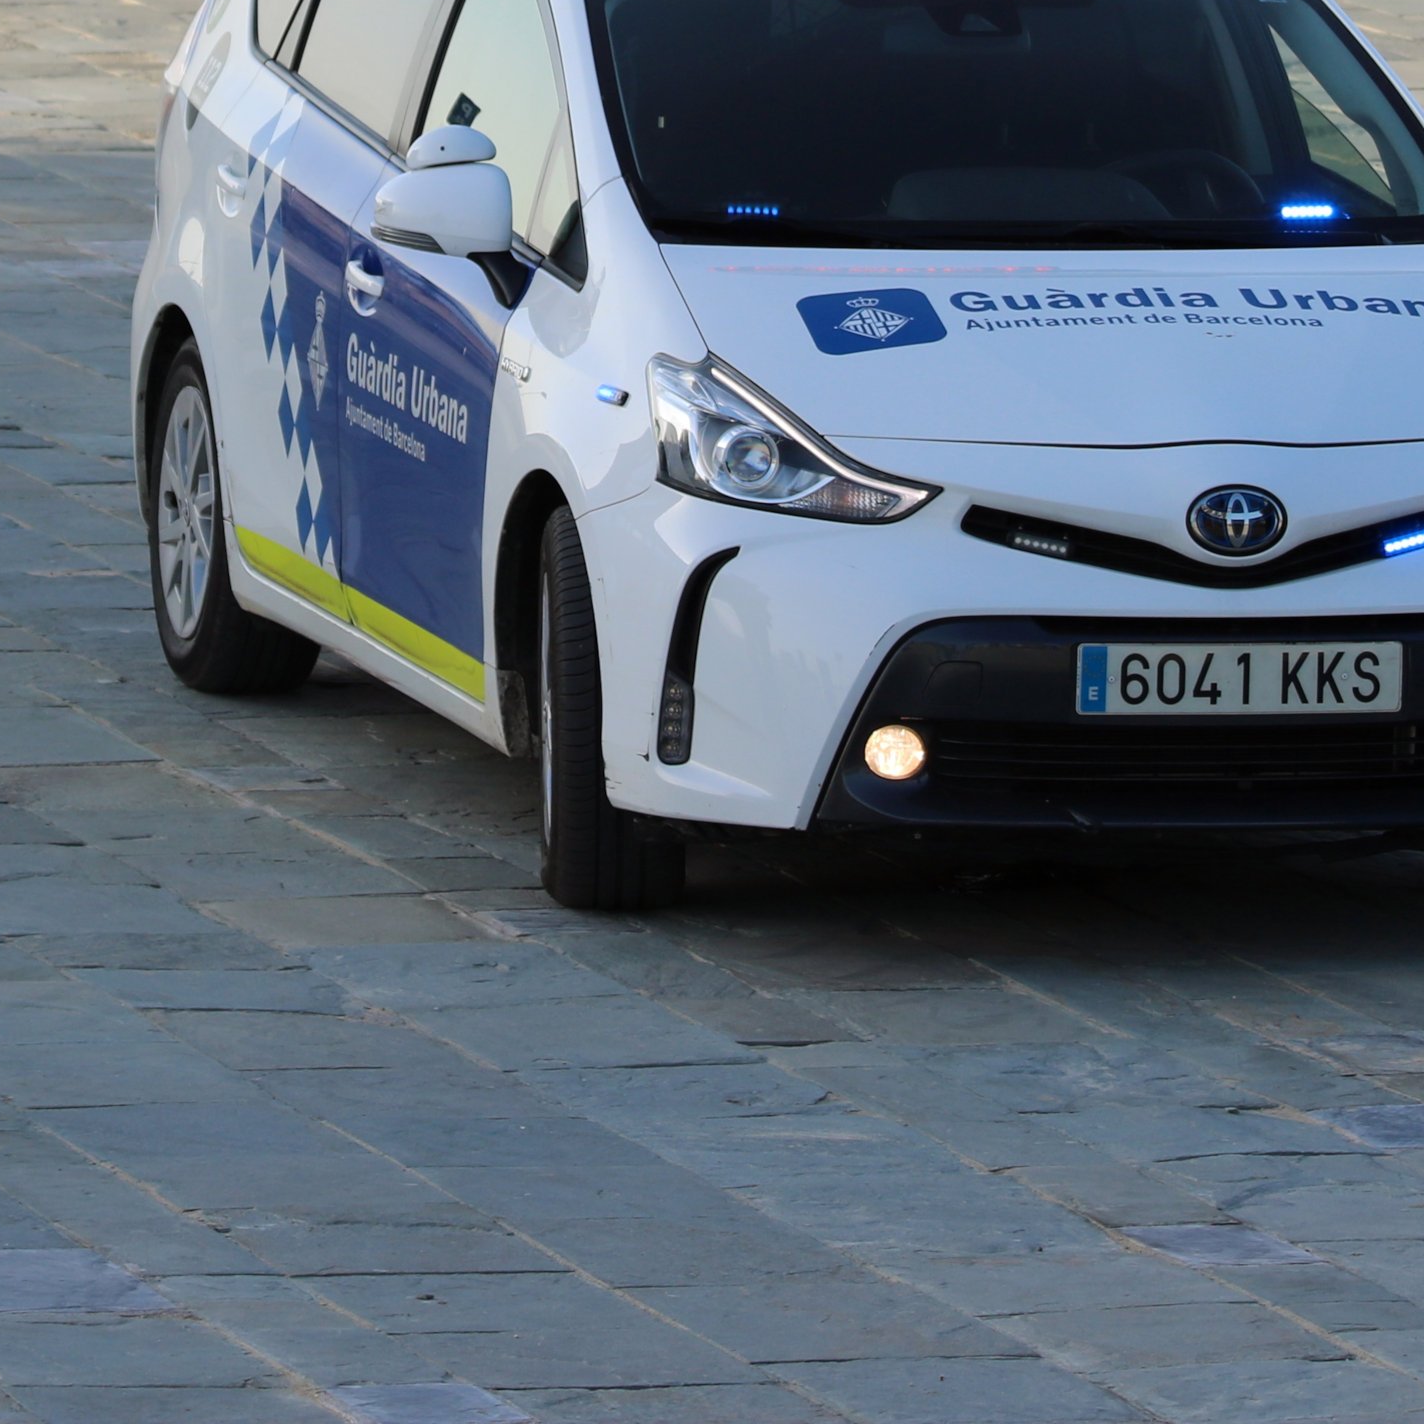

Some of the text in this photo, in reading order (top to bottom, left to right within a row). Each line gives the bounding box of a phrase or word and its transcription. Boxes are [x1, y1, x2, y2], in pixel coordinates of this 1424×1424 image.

[949, 287, 1219, 313] Guàrdia
[966, 313, 1324, 332] Ajuntament de Barcelona
[347, 332, 468, 444] Guàrdia Urbana
[346, 396, 425, 462] Ajuntament de Barcelona
[1088, 651, 1380, 705] E 6041 KKS
